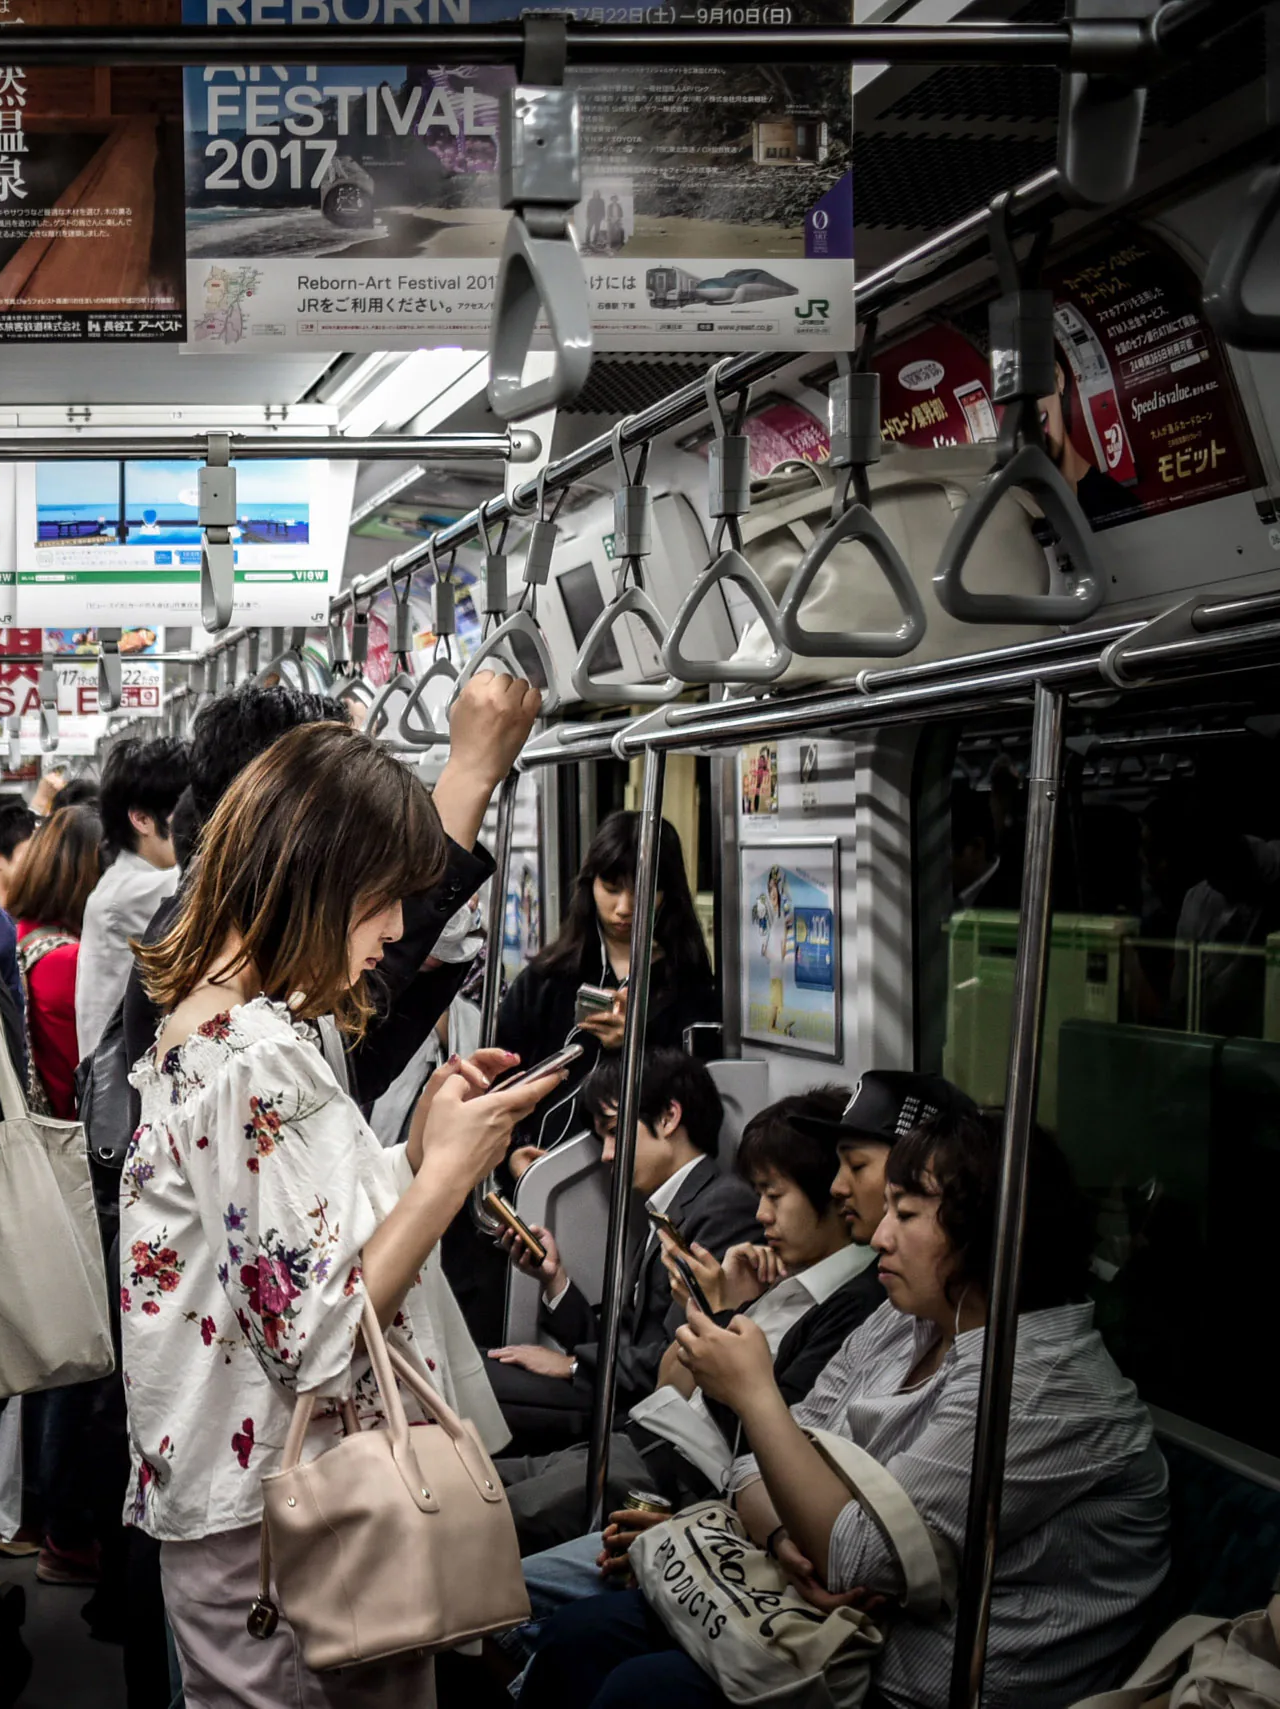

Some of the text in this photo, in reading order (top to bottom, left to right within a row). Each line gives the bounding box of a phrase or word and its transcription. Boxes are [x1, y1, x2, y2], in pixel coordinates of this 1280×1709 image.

[207, 86, 497, 136] FESTIVAL
[204, 139, 338, 190] 2017
[297, 275, 498, 291] Reborn-Art Festival 201
[585, 275, 637, 291] けには
[297, 297, 454, 313] JRをご利用ください。
[795, 299, 830, 319] JR
[138, 320, 184, 332] アーベスト
[880, 395, 949, 441] ードローン業界初!
[1130, 390, 1158, 423] Speed
[1157, 439, 1227, 484] モビット
[654, 1536, 727, 1640] PRODUCTS
